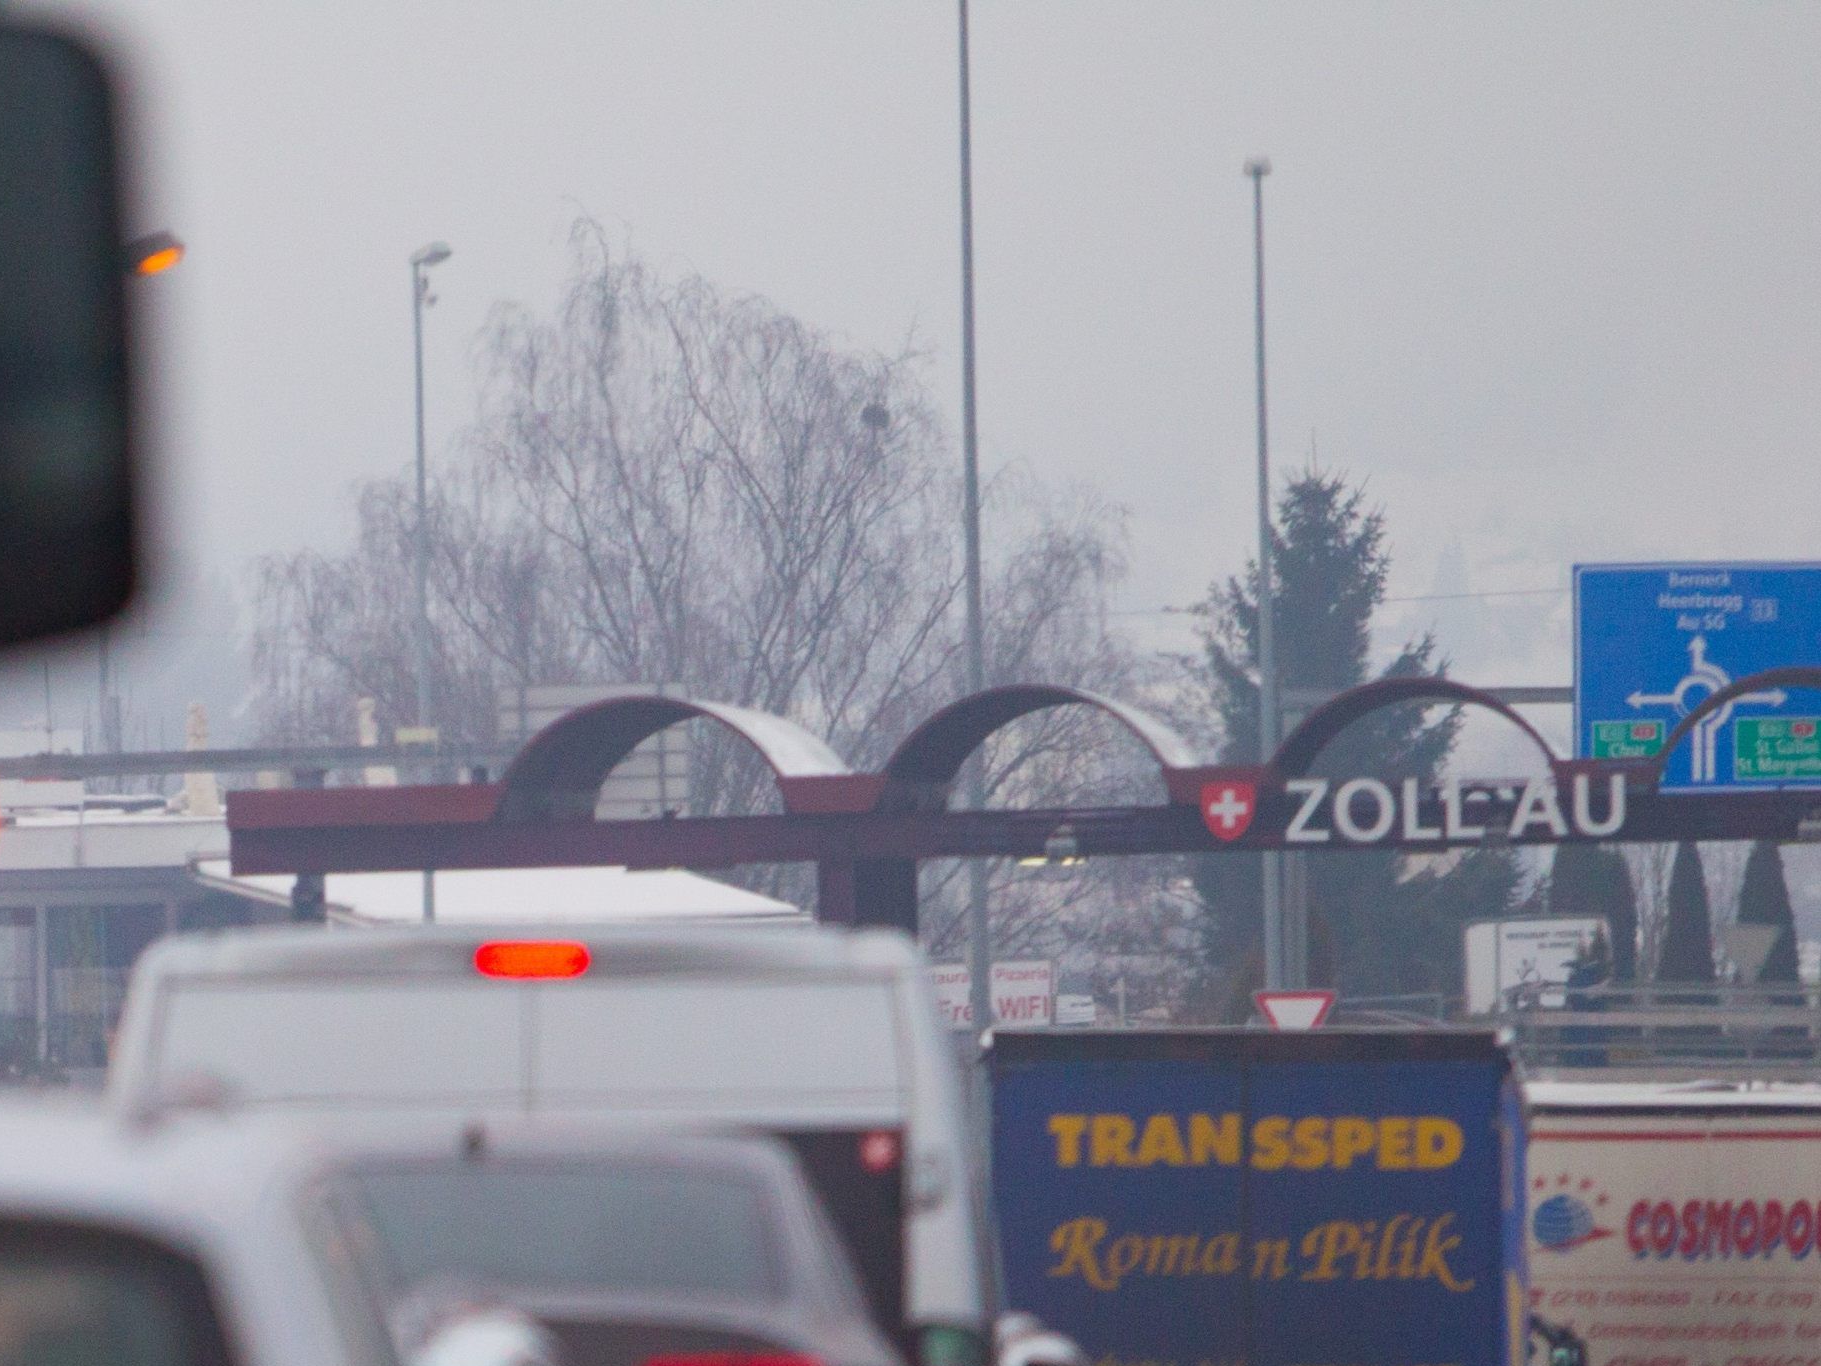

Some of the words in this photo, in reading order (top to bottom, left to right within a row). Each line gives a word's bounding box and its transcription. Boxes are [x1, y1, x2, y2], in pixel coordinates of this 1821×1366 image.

[1657, 593, 1743, 613] Heerbrugg
[1704, 613, 1726, 630] SG
[1285, 777, 1485, 842] ZOLL
[1508, 772, 1627, 837] AU
[937, 998, 975, 1021] Fre
[996, 995, 1050, 1019] WIFI
[1626, 1198, 1821, 1262] COSMOPO
